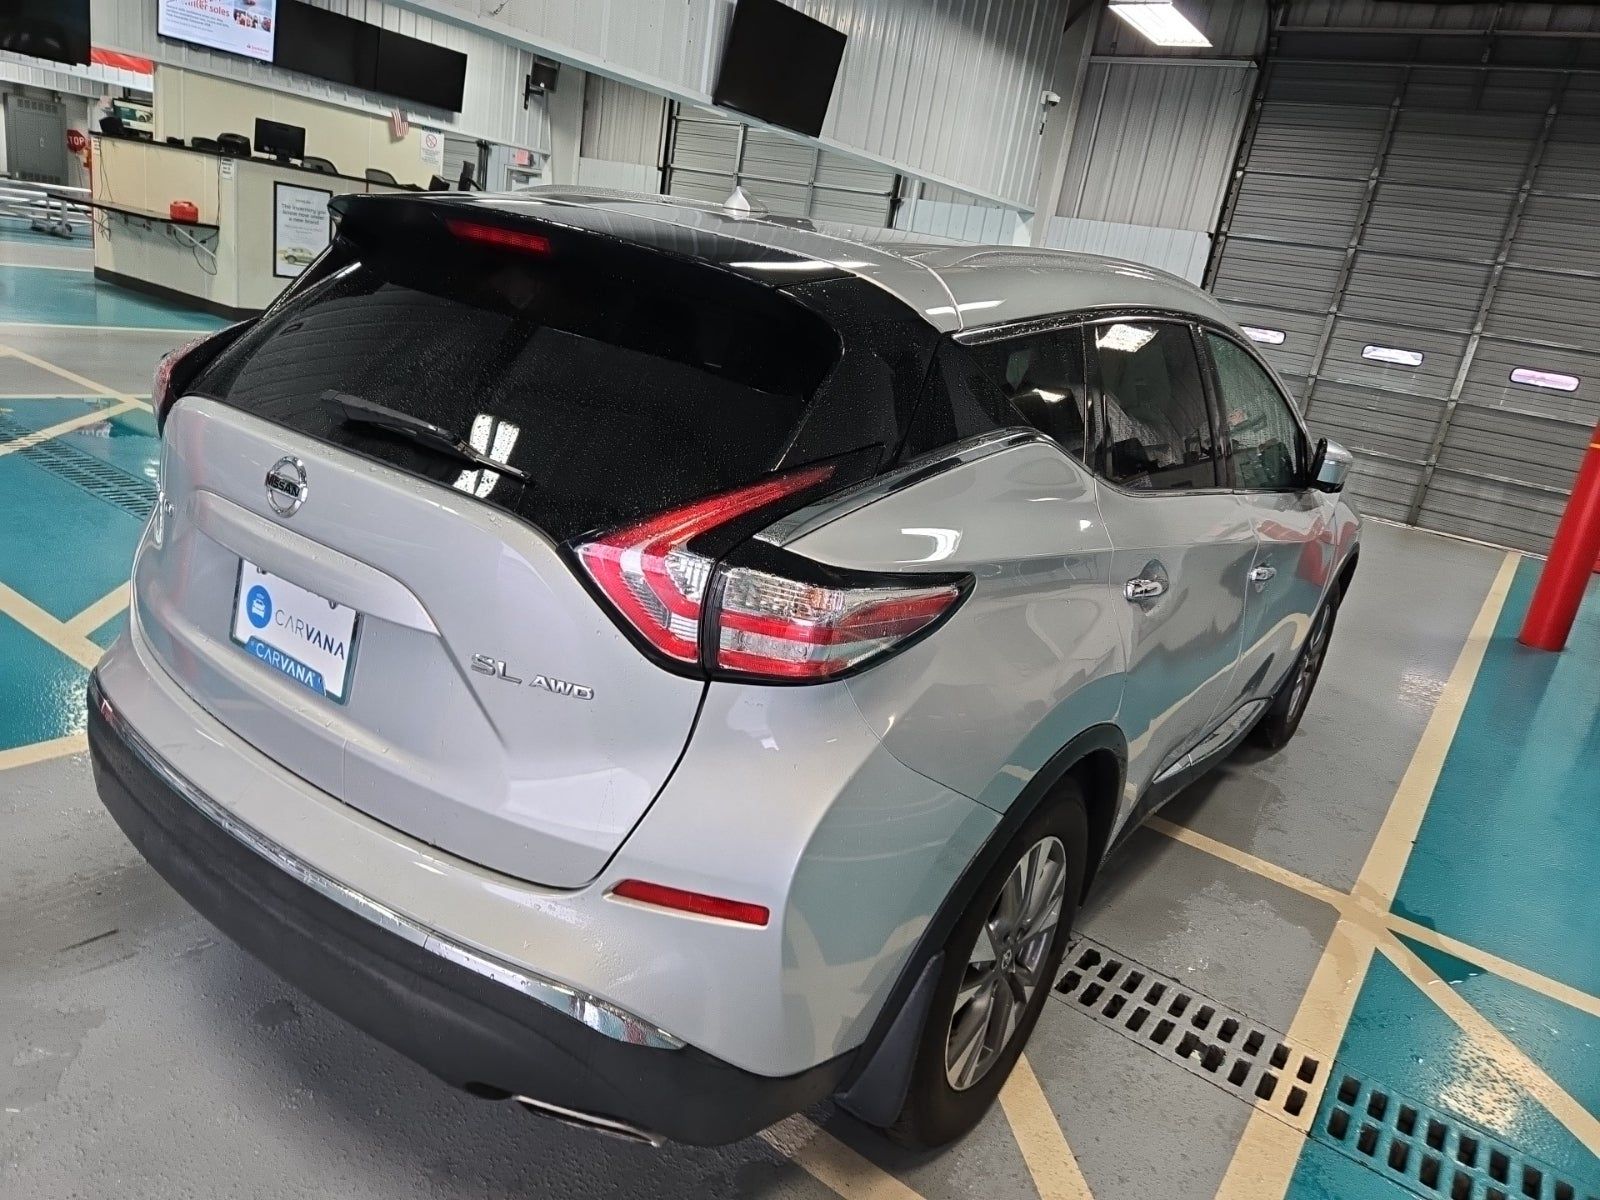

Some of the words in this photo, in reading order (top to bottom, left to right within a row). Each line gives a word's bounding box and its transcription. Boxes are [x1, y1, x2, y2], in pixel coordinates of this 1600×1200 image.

[67, 136, 85, 146] TOP
[265, 471, 300, 498] NISSAN
[275, 609, 344, 660] CARVANA
[470, 653, 522, 684] SL
[528, 674, 595, 700] AWD
